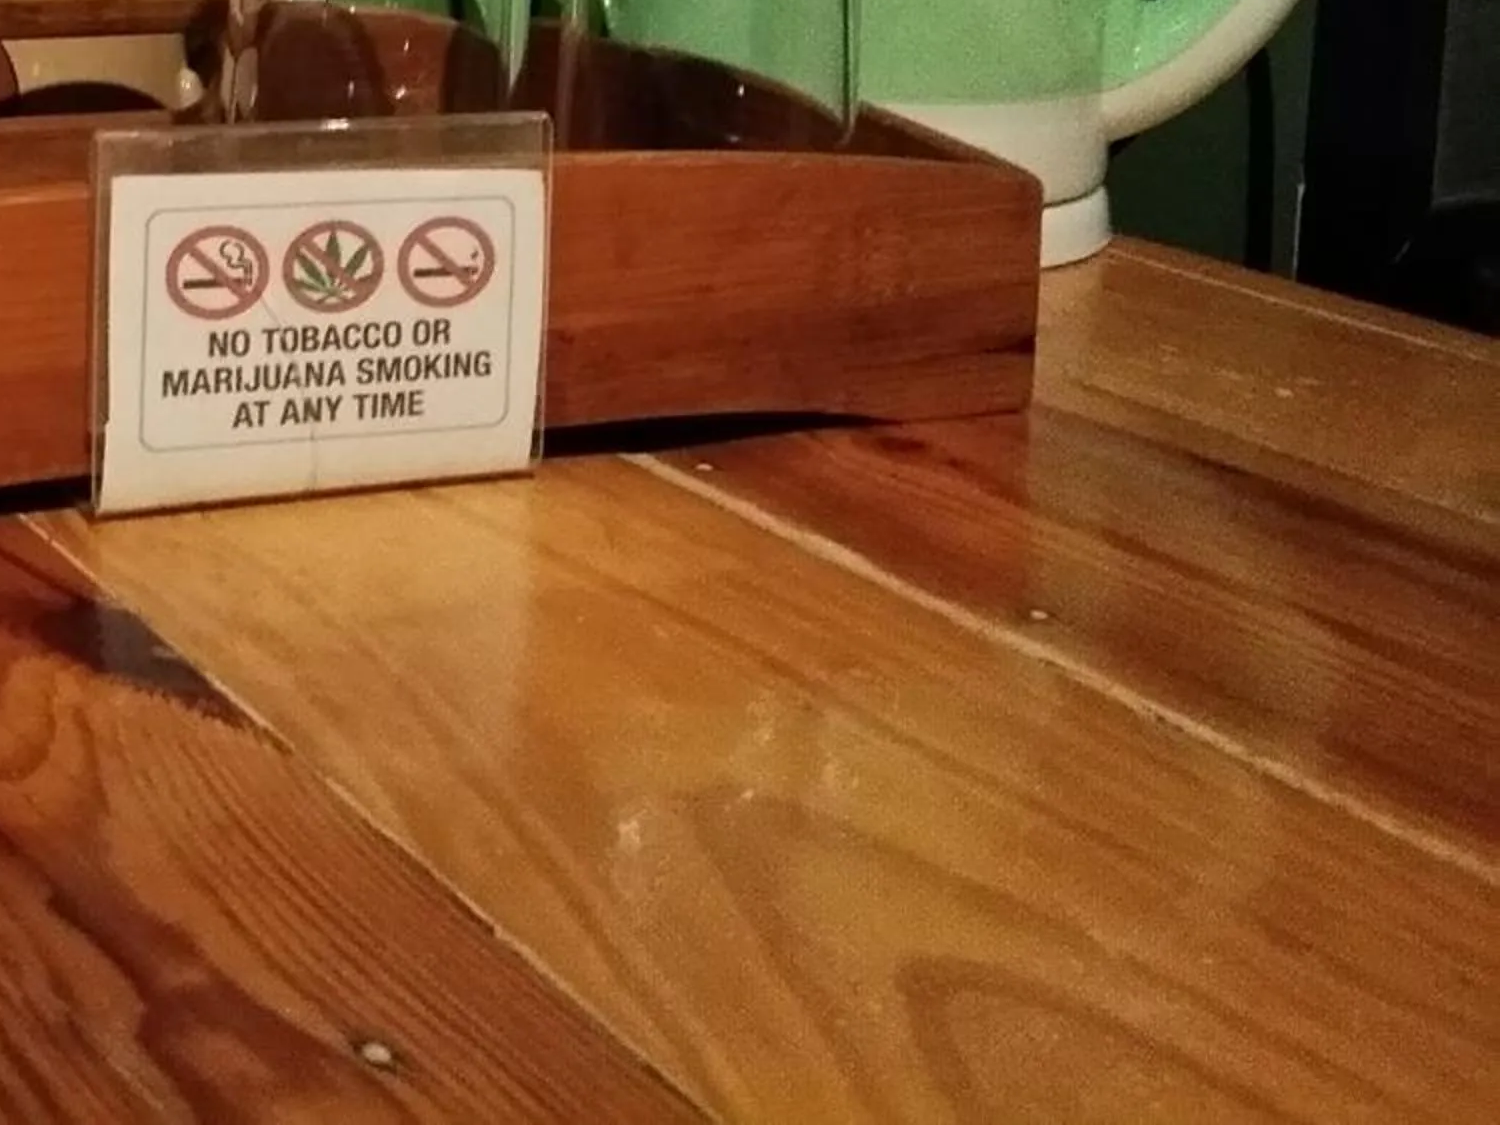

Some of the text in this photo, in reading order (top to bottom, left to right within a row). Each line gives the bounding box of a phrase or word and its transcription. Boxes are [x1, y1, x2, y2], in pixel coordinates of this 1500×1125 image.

[208, 318, 452, 358] NO TOBACCO OR
[161, 350, 493, 398] MARIJUANA SMOKING
[231, 389, 426, 430] AT ANY TIME
